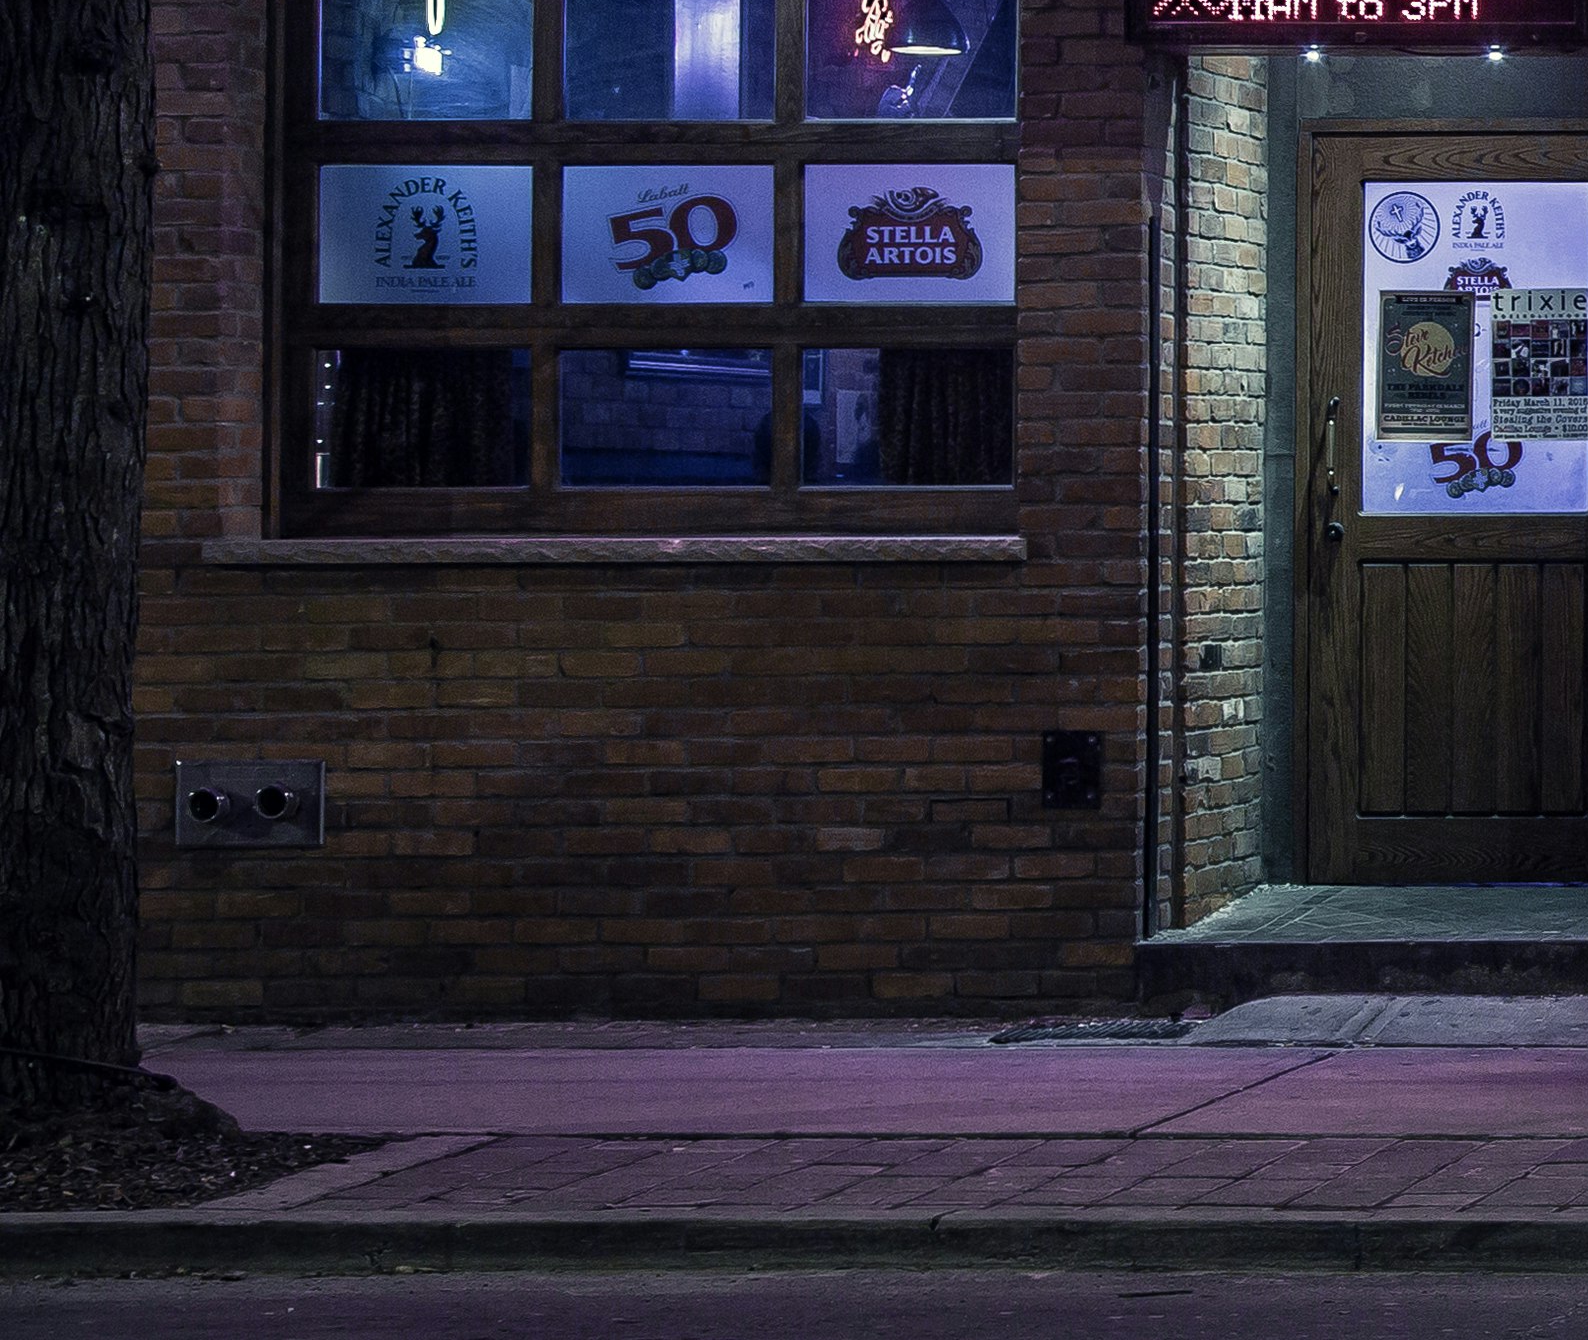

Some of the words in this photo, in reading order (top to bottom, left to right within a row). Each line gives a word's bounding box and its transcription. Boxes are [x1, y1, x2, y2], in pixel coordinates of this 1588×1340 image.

[637, 183, 690, 203] Labatt
[375, 176, 447, 268] ALEXANDER
[447, 189, 479, 269] KEITH'S
[1451, 190, 1489, 239] ALEXANDER
[1488, 196, 1505, 239] KEITH'S
[608, 194, 740, 272] 50
[865, 226, 956, 245] STELLA
[864, 247, 957, 265] ARTOIS
[375, 276, 414, 287] INDIA
[418, 276, 449, 287] PALE
[452, 276, 476, 287] ALE
[1456, 276, 1500, 285] STELLA
[1492, 290, 1587, 311] trixie
[1384, 321, 1429, 357] Steve
[1493, 398, 1521, 408] Friday
[1524, 398, 1550, 406] March
[1493, 415, 1534, 425] Stealing
[1555, 415, 1588, 423] Covers
[1430, 431, 1522, 484] 50
